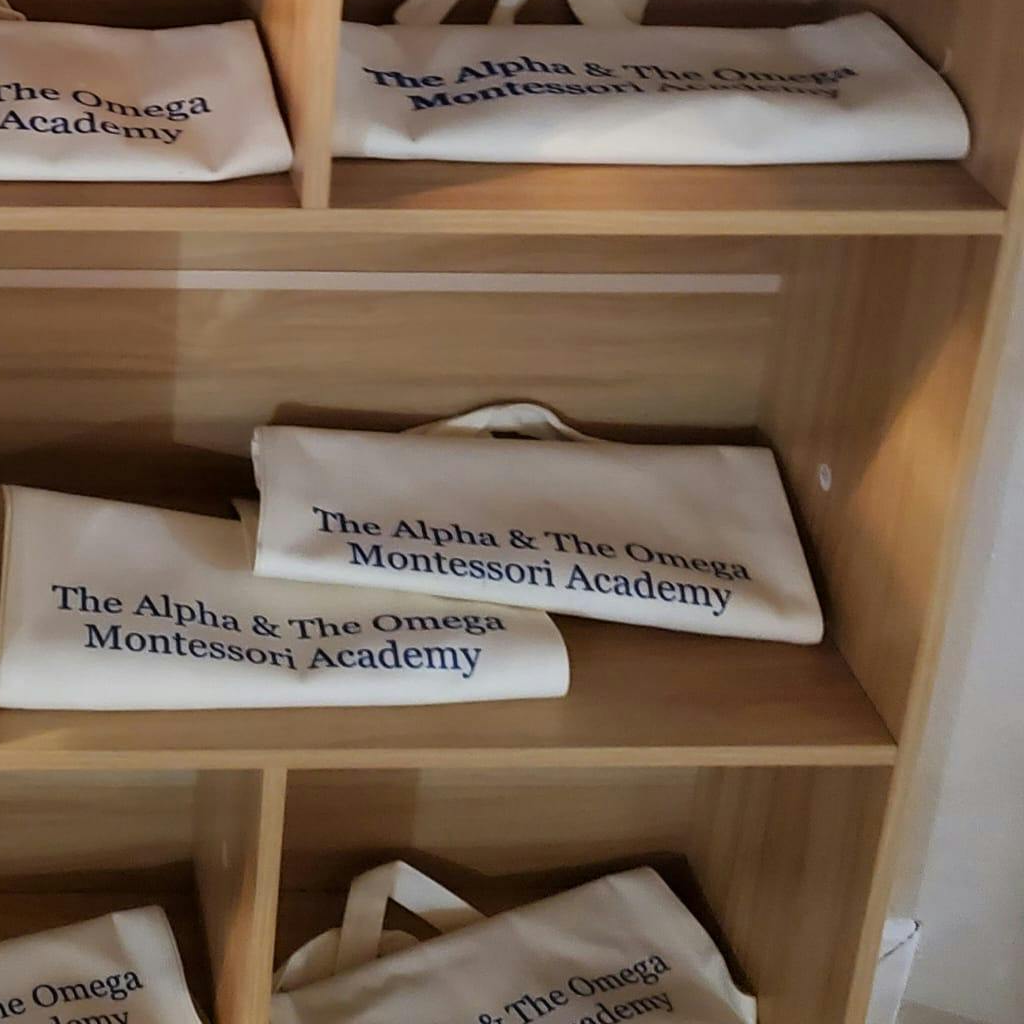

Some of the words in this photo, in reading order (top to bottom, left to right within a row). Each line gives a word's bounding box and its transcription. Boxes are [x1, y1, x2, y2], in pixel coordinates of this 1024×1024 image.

[362, 67, 445, 88] The
[455, 56, 575, 84] Alpha
[583, 62, 618, 77] &
[622, 65, 703, 79] The
[72, 89, 212, 122] Omega
[407, 80, 645, 110] Montessori
[0, 113, 184, 144] Academy
[312, 507, 379, 538] The
[391, 519, 499, 549] Alpha
[510, 530, 537, 550] &
[544, 531, 616, 560] The
[625, 543, 752, 581] Omega
[348, 542, 554, 588] Montessori
[563, 563, 733, 616] Academy
[52, 585, 123, 615] The
[133, 596, 241, 632] Alpha
[252, 614, 281, 637] &
[288, 615, 362, 639] The
[372, 610, 506, 633] Omega
[83, 624, 295, 670] Montessori
[310, 641, 482, 677] Academy
[31, 970, 144, 1008] Omega
[504, 989, 569, 1024] The
[567, 956, 671, 997] Omega
